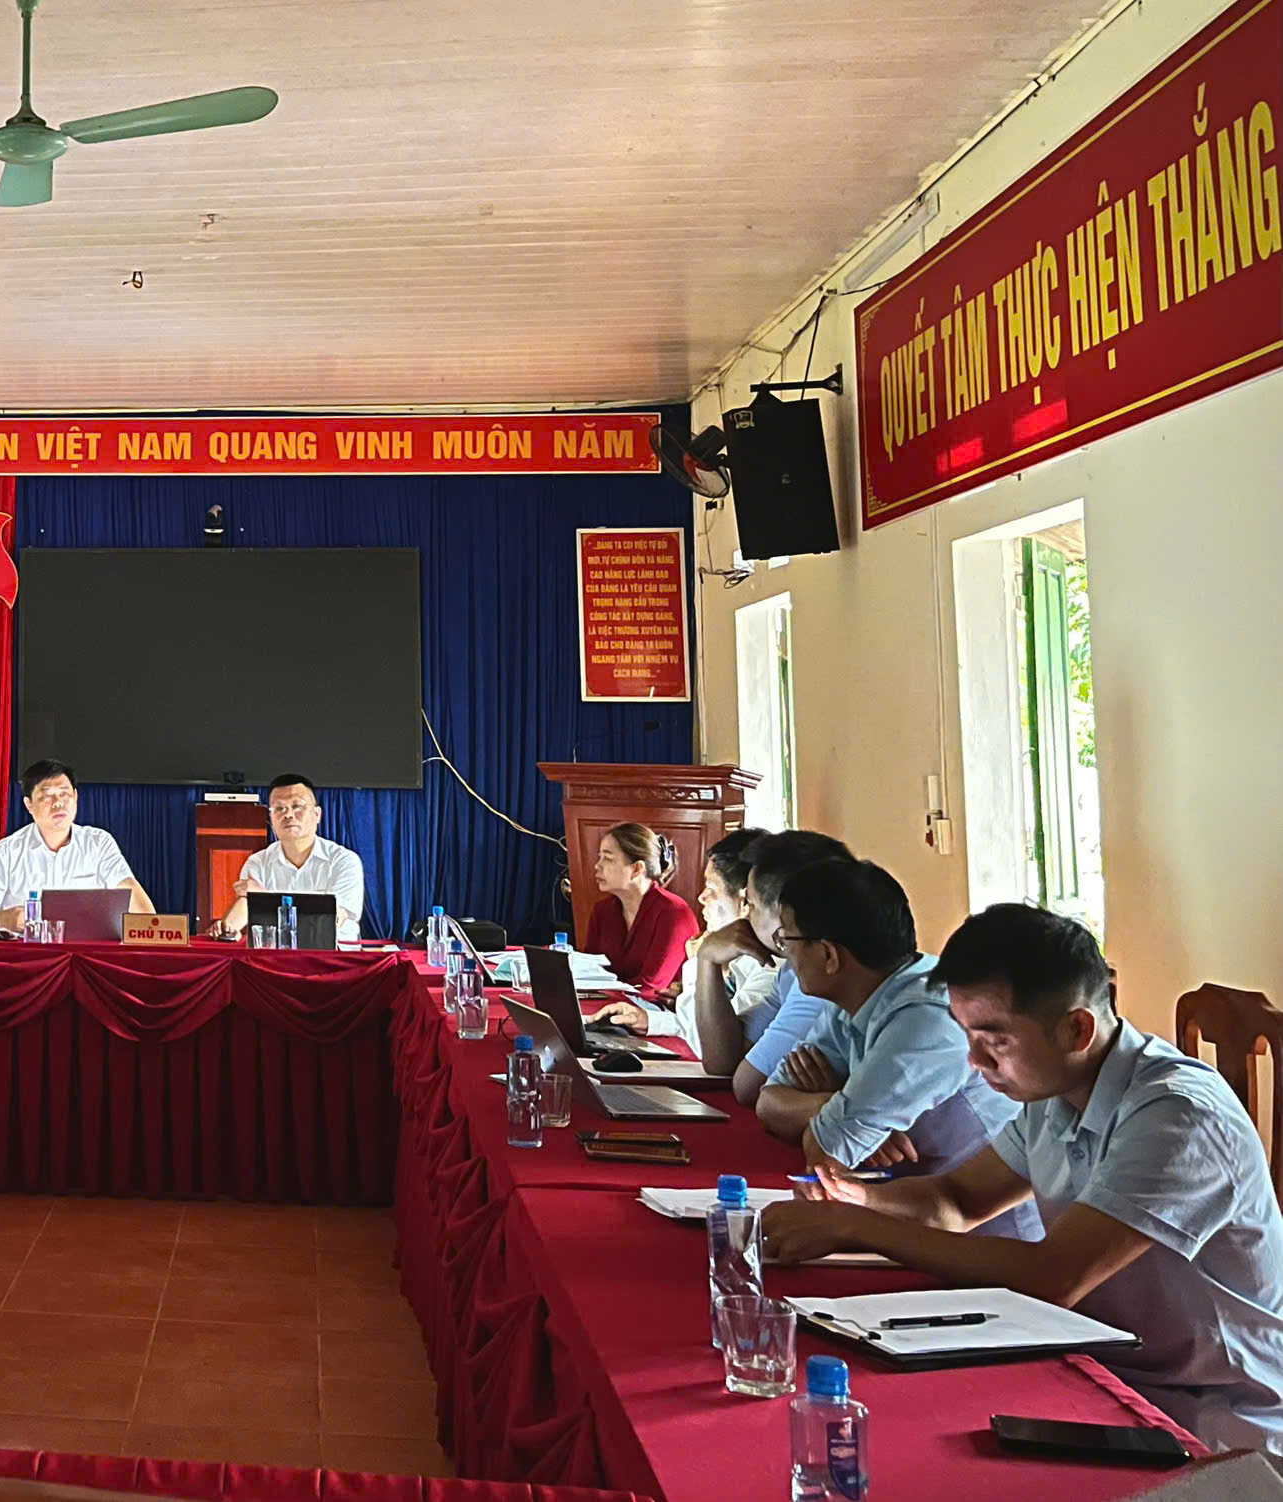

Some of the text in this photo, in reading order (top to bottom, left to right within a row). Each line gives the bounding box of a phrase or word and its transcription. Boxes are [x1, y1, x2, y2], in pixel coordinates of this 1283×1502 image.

[880, 82, 1283, 463] QUYẾT TÂM THỰC HIỆN THẮNG
[36, 425, 101, 468] VIỆT
[118, 432, 192, 461] NAM
[208, 430, 317, 462] QUANG
[335, 431, 413, 460] VINH
[433, 423, 532, 460] MUÔN
[553, 422, 634, 460] NĂM
[128, 926, 183, 941] CHỦ TỌA
